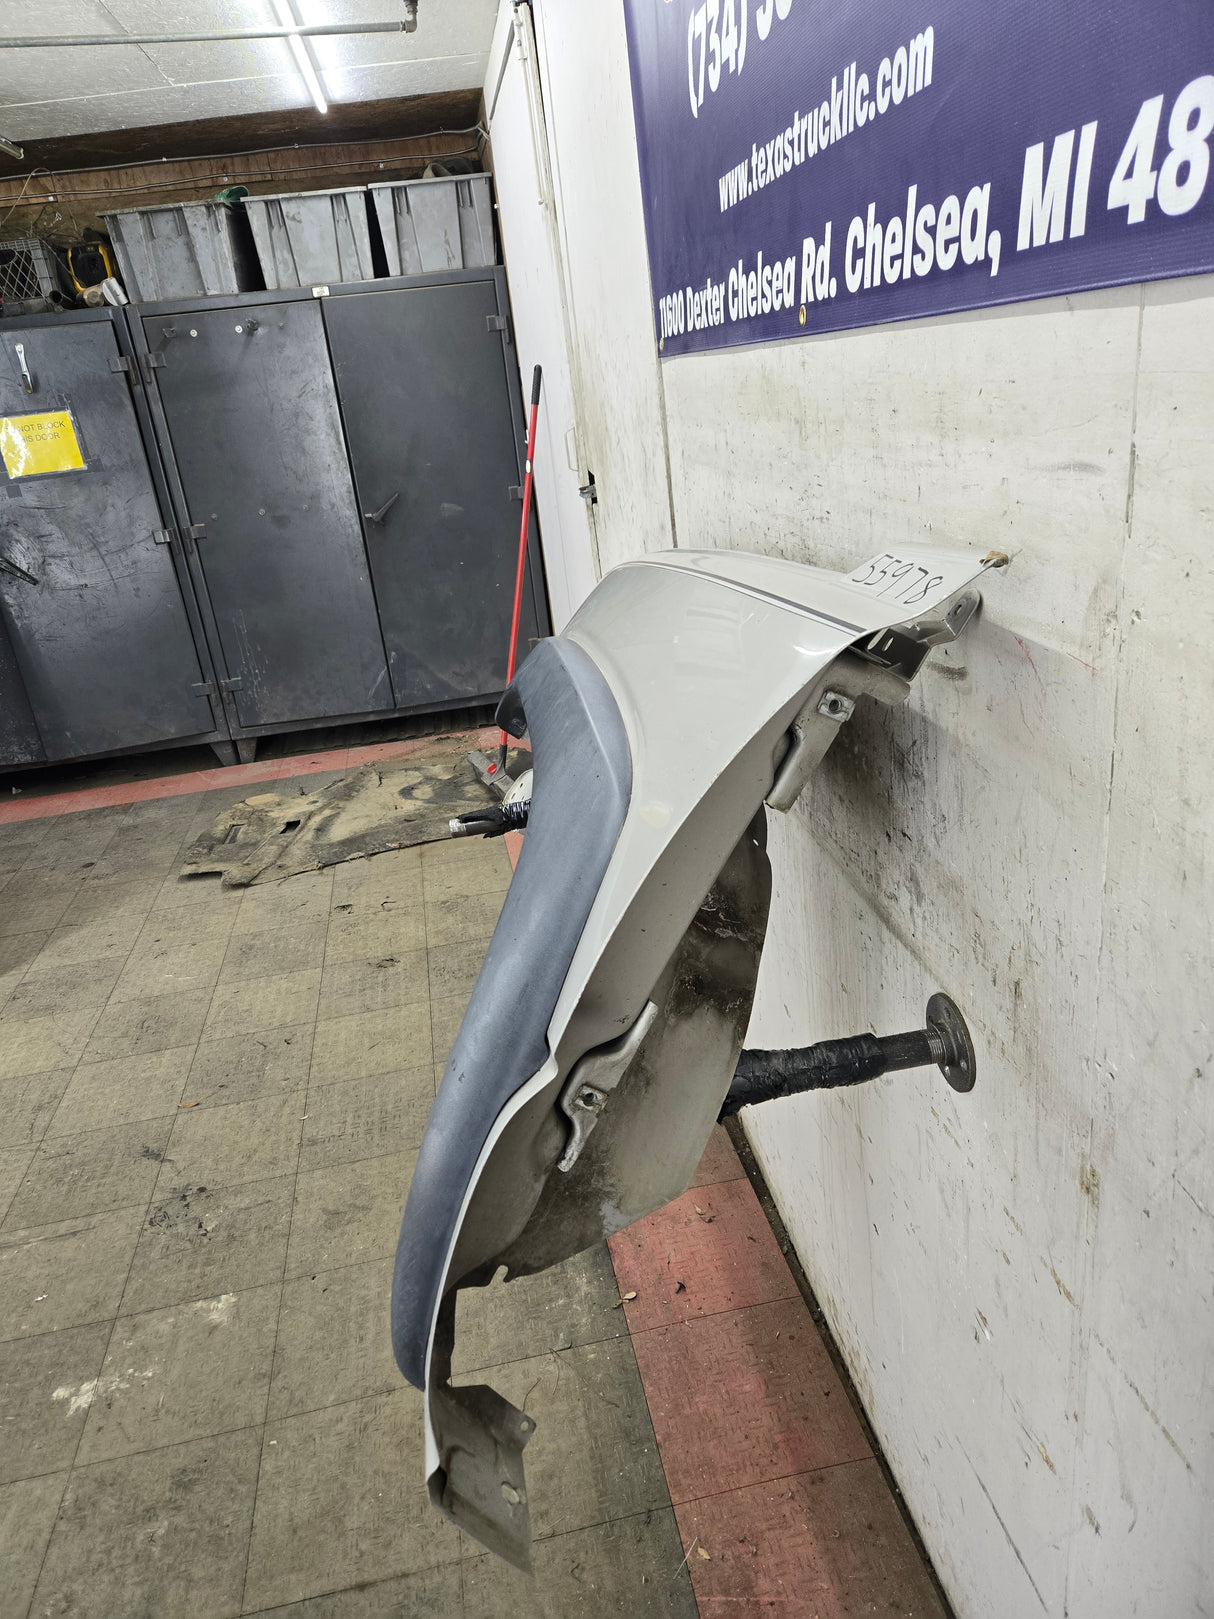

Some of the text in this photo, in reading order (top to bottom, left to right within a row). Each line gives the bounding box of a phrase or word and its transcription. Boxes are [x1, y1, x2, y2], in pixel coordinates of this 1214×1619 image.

[719, 25, 935, 213] www.texastruckllc.com
[659, 289, 685, 338] 11600
[686, 278, 726, 332] Dexter
[728, 250, 796, 322] Chelsea
[801, 221, 837, 304] Rd.
[844, 182, 1002, 293] Chelsea,
[1016, 120, 1098, 252] MI
[35, 432, 61, 442] DOOR
[37, 420, 66, 431] BLOCK
[852, 554, 943, 604] 55978
